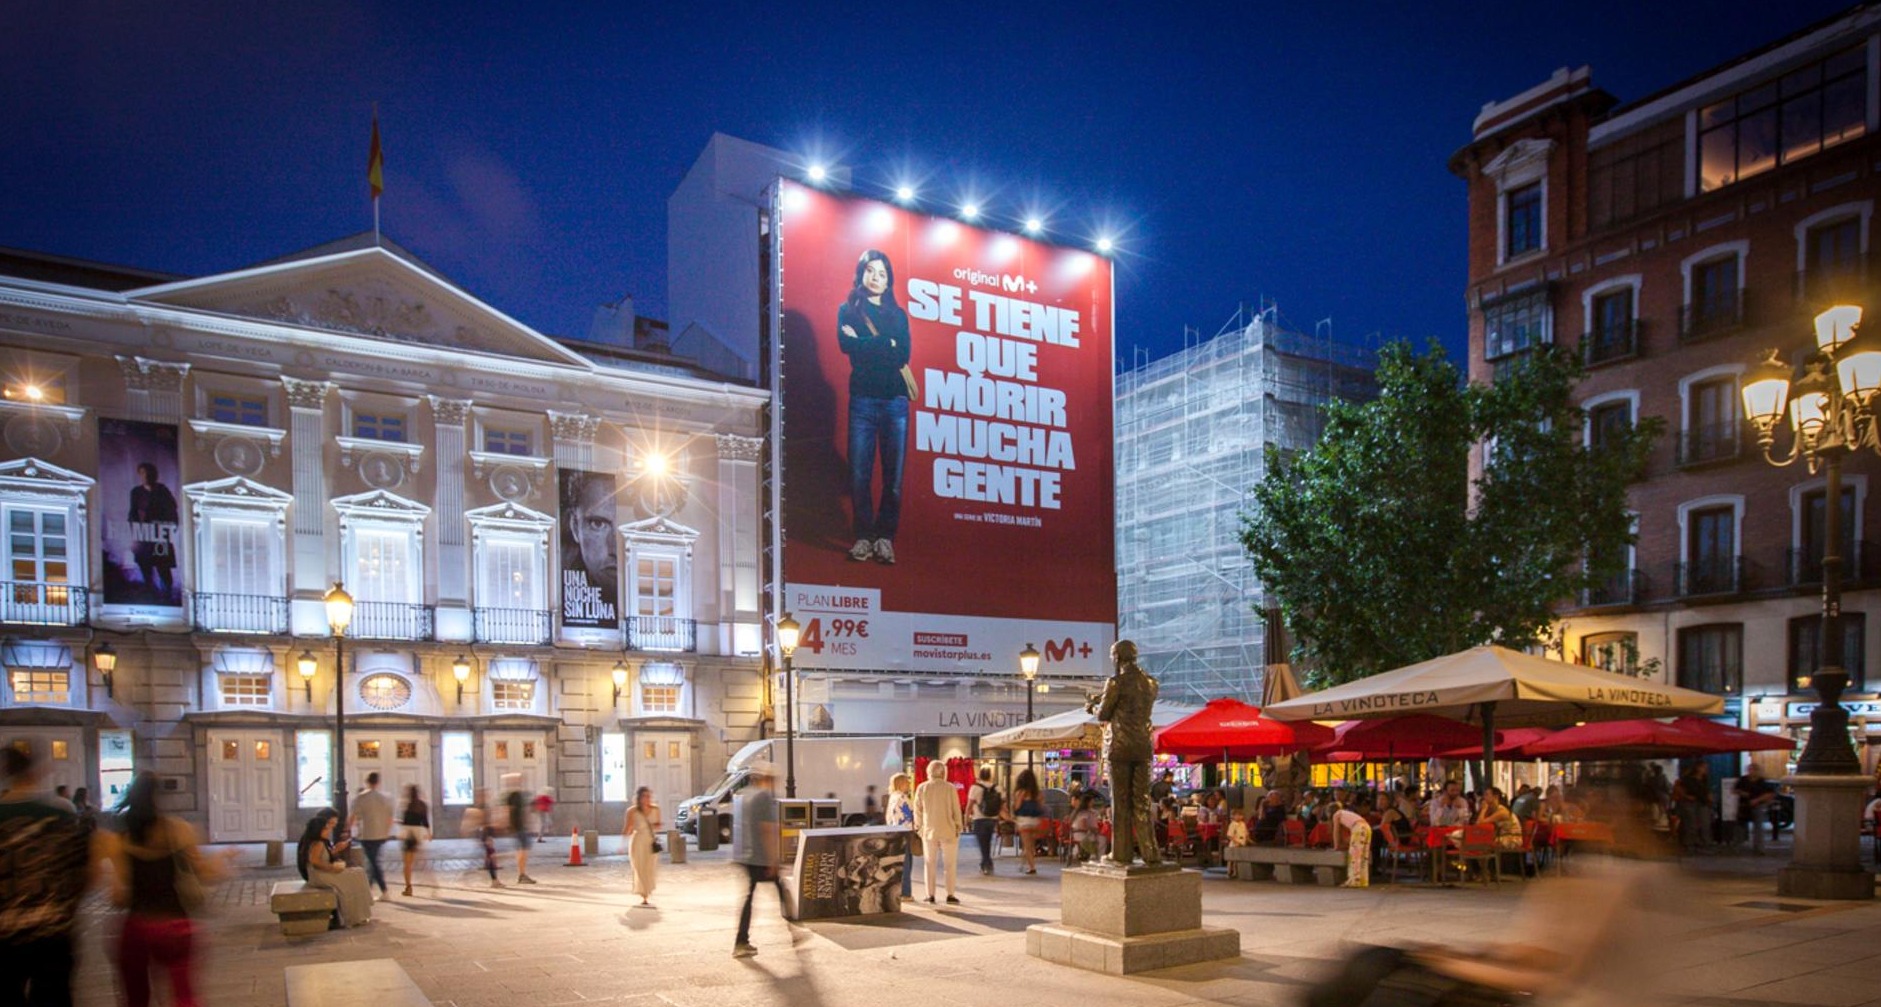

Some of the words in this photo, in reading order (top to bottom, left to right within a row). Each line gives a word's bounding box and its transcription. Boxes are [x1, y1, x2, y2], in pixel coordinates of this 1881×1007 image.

[953, 268, 1000, 288] original
[907, 277, 963, 327] SE
[968, 290, 1080, 349] TIENE
[956, 330, 1039, 383] QUE
[924, 368, 1067, 428] MORIR
[915, 410, 1076, 470] MUCHA
[933, 457, 1061, 510] GENTE
[564, 570, 588, 587] UNA
[564, 585, 603, 603] NOCHE
[797, 593, 830, 607] PLAN
[832, 595, 869, 609] LIBRE
[564, 601, 584, 618] SIN
[585, 602, 616, 620] LUNA
[830, 642, 857, 656] MES
[913, 648, 992, 661] movistarplus.es
[1312, 703, 1334, 716] LA
[1340, 691, 1440, 712] VINOTECA
[1588, 687, 1605, 700] LA
[1608, 688, 1673, 706] VINOTECA
[938, 712, 960, 728] LA
[803, 854, 815, 899] ARTURO
